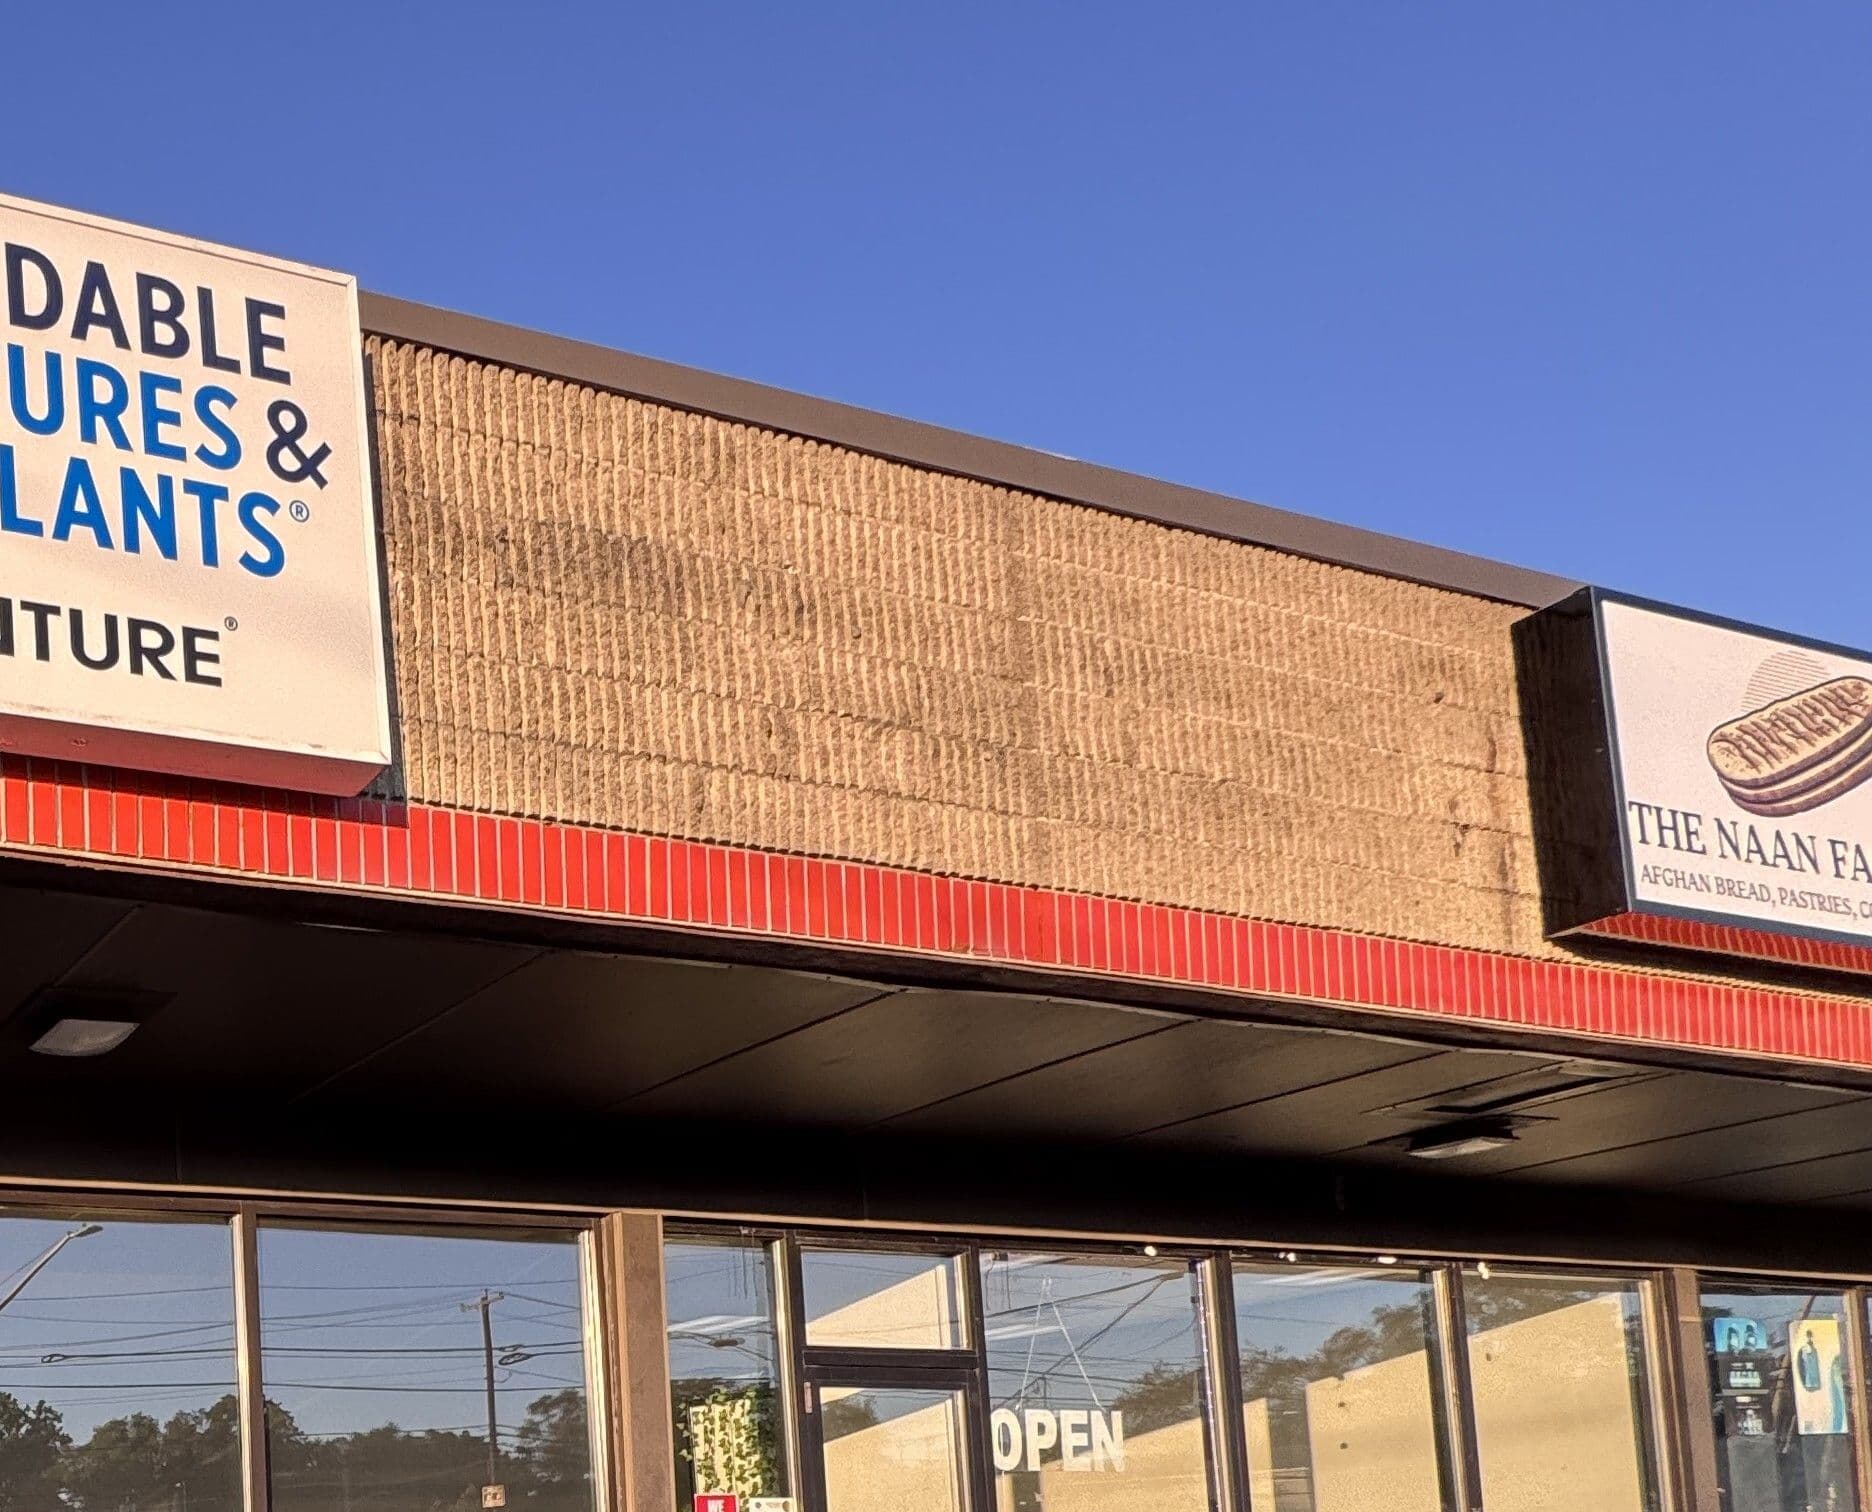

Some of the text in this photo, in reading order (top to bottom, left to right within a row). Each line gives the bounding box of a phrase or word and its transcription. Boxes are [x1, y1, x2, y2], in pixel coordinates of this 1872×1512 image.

[265, 399, 333, 490] &
[1628, 800, 1707, 855] THE
[1713, 817, 1821, 874] NAAN
[1641, 863, 1712, 894] AFGHAN
[1715, 876, 1776, 909] BREAD,
[1778, 887, 1858, 920] PASTRIES,
[990, 1407, 1126, 1473] OPEN
